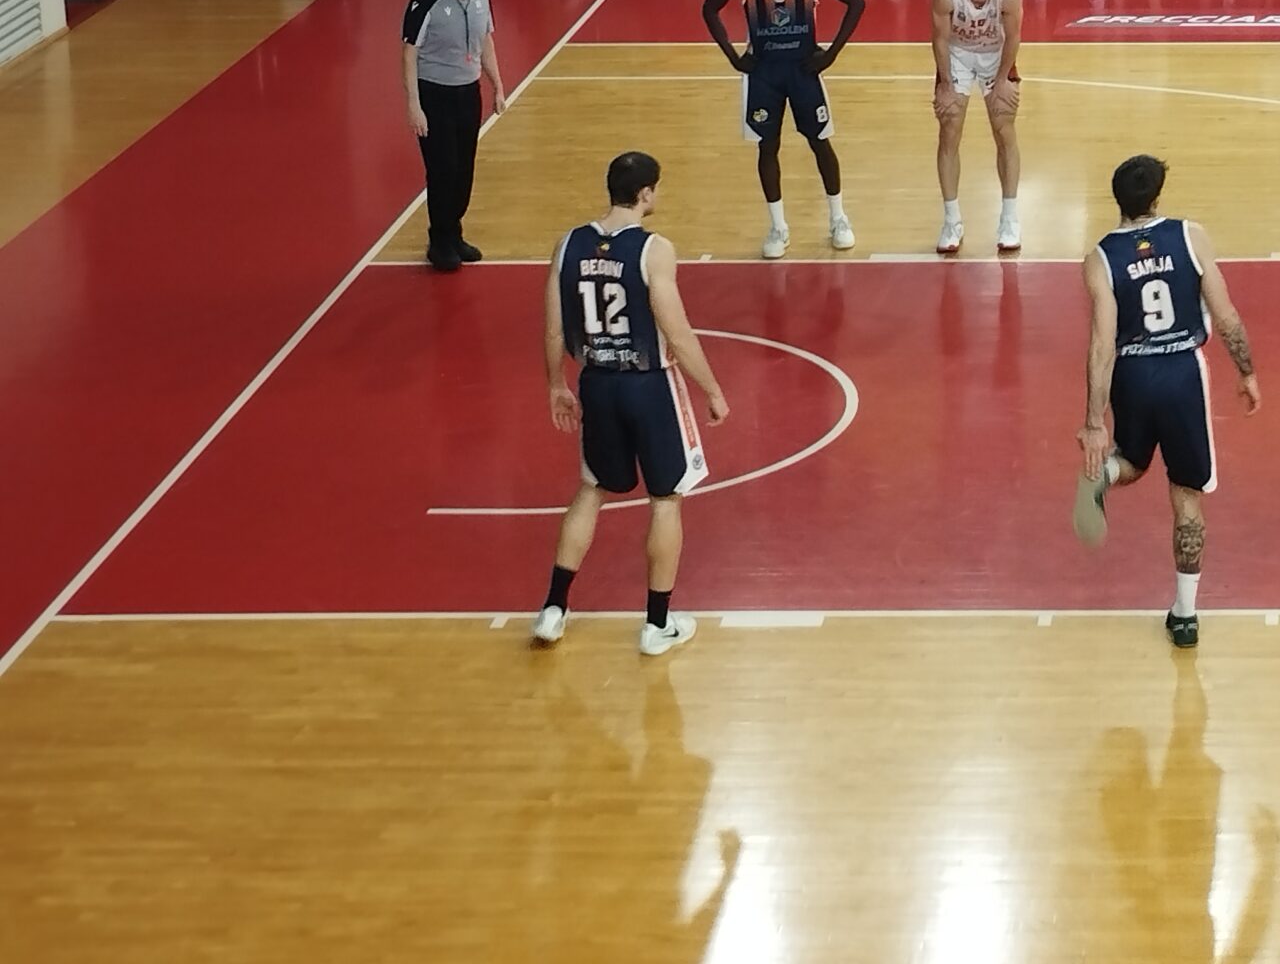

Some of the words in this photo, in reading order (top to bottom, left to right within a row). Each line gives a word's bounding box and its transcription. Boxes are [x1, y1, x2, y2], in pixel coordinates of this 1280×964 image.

[815, 105, 829, 123] 8
[578, 281, 630, 335] 12
[1141, 279, 1176, 333] 9
